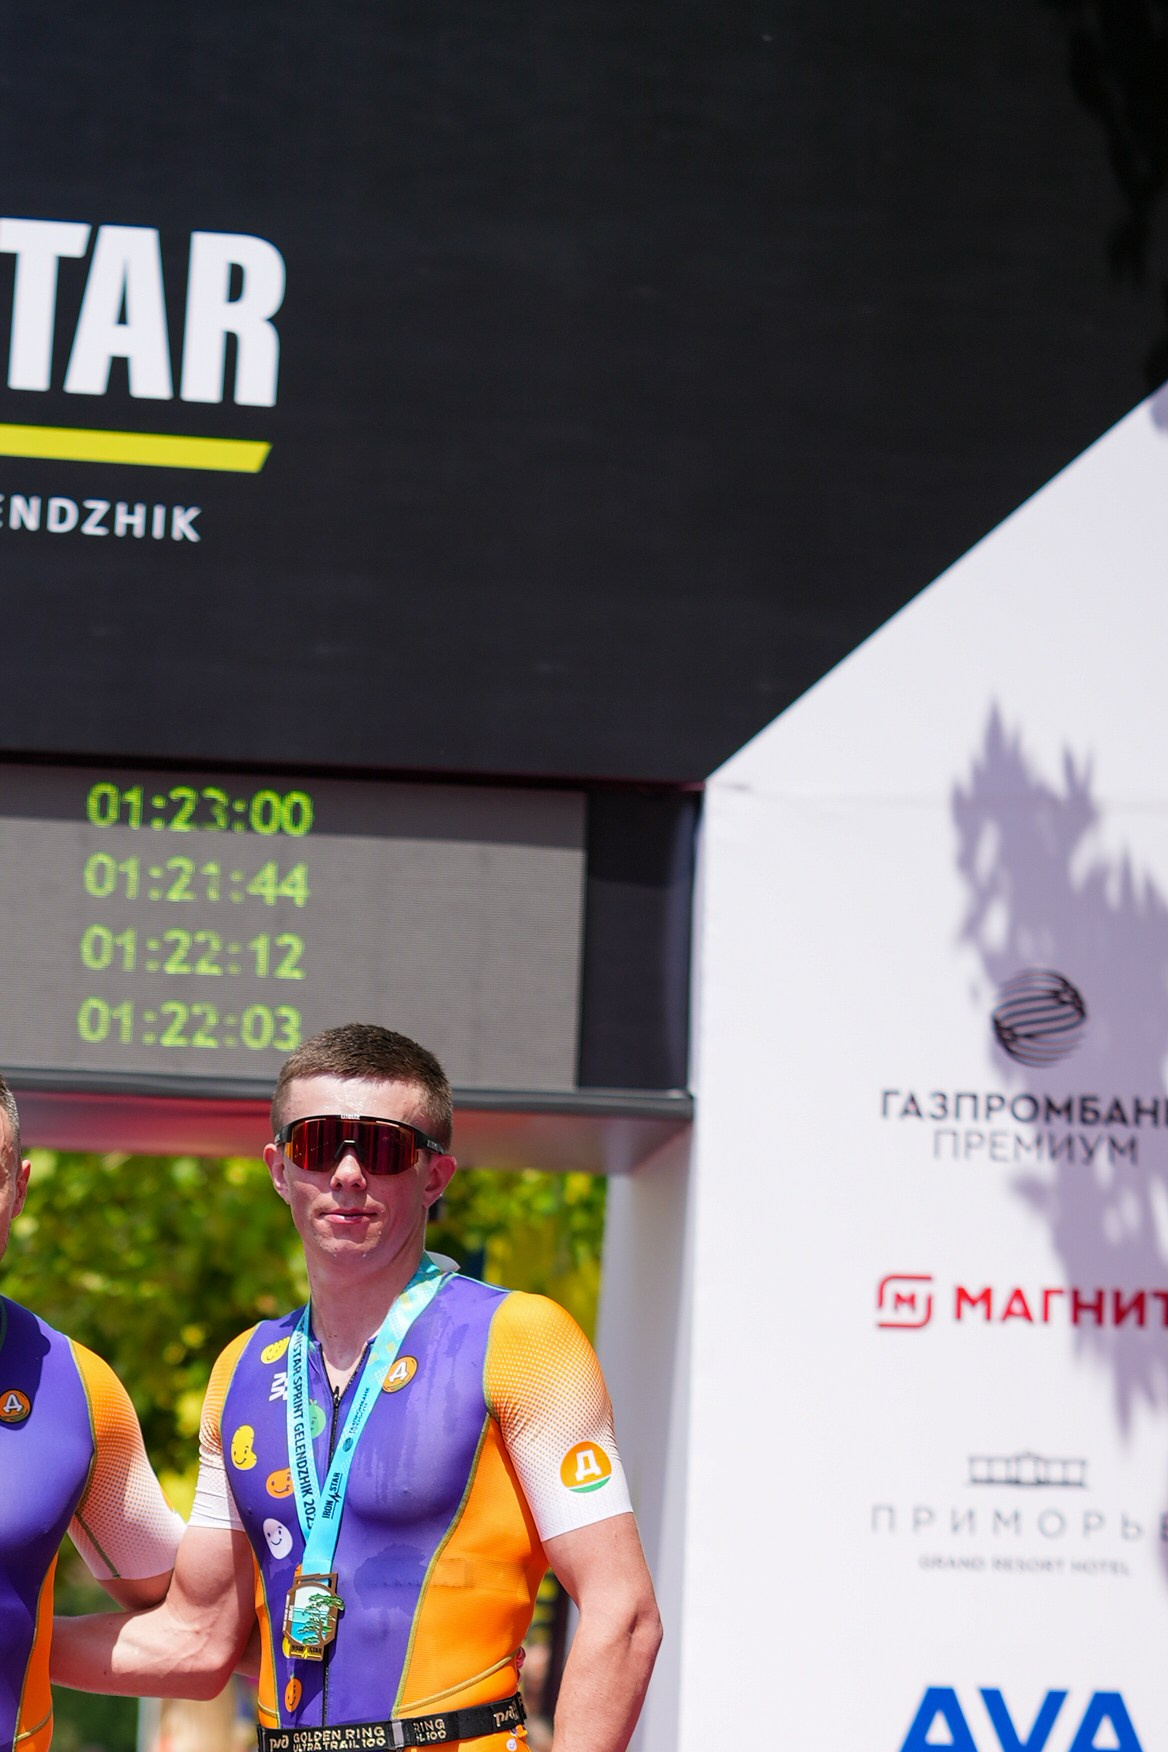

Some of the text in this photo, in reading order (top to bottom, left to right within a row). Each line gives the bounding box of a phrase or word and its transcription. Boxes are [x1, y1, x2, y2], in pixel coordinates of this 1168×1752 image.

[86, 782, 314, 836] 01:23:00
[83, 853, 310, 907] 01:21:44
[80, 924, 306, 981] 01:22:12
[78, 997, 302, 1051] 01:22:03
[881, 1090, 1168, 1128] ГАЗПРОМБАН
[933, 1130, 1138, 1166] ПРЕМИУМ
[293, 1376, 304, 1419] SPRINT
[294, 1422, 313, 1498] GELENDZHIK
[322, 1472, 341, 1519] IRON STAR
[293, 1726, 386, 1744] GOLDEN RING
[293, 1737, 386, 1752] ULTRA TRAIL 100
